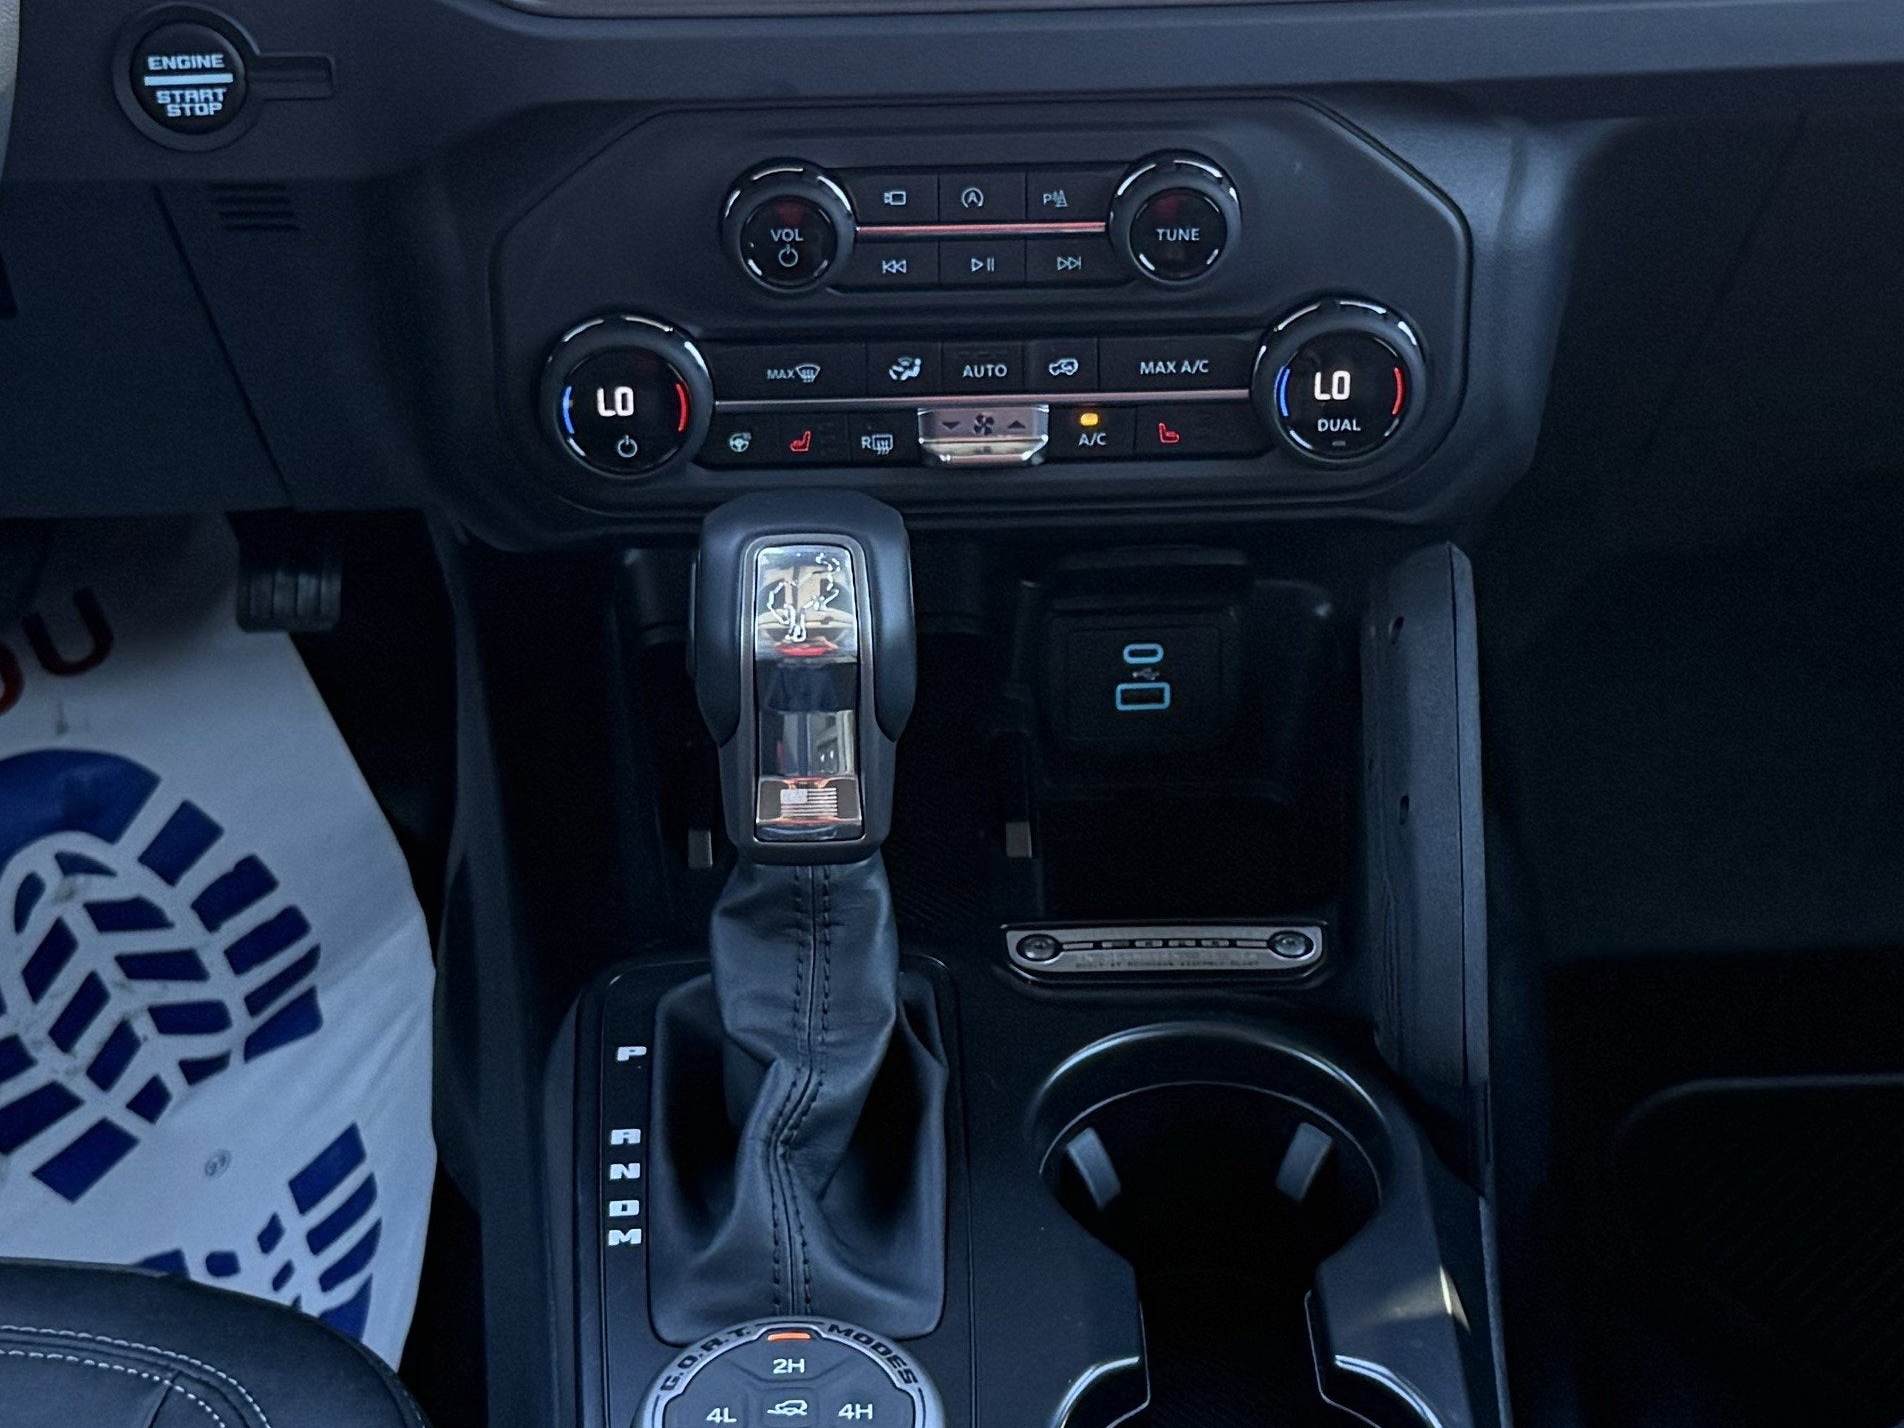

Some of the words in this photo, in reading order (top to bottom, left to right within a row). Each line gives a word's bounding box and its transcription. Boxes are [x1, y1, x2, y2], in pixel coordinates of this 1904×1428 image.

[148, 53, 225, 71] ENGINE
[156, 88, 227, 105] START
[166, 102, 223, 118] STOP
[770, 228, 804, 243] VOL
[1157, 227, 1200, 243] TUNE
[767, 369, 796, 380] MAX
[962, 364, 1008, 378] AUTO
[1140, 360, 1177, 375] MAX
[1181, 359, 1210, 374] A/C
[1314, 370, 1351, 401] LO
[596, 385, 635, 417] LO
[1317, 418, 1361, 432] DUAL
[1078, 432, 1107, 446] A/C
[615, 1045, 647, 1063] P
[609, 1128, 642, 1146] R
[609, 1162, 642, 1180] N
[608, 1199, 642, 1217] D
[607, 1228, 644, 1247] M
[828, 1323, 919, 1386] MODES
[773, 1358, 806, 1374] 2H
[706, 1407, 737, 1424] 4L
[838, 1403, 873, 1420] 4H
